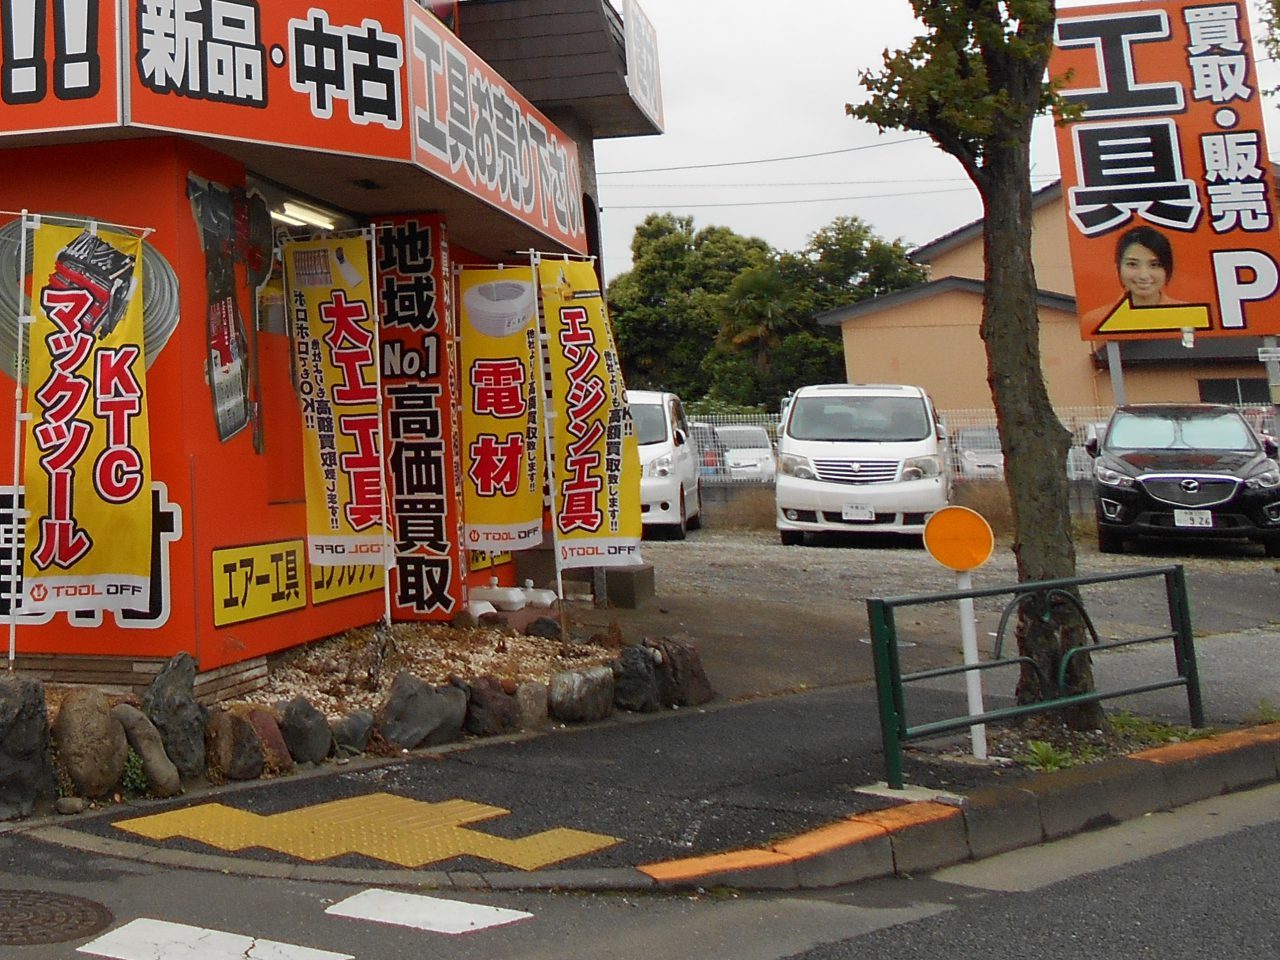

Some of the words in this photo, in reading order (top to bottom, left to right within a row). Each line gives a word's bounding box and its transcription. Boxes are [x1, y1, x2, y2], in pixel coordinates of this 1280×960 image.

[411, 15, 586, 238] 工具お売り下さい
[1054, 9, 1202, 237] 工具
[1183, 2, 1272, 233] 買取・販売
[1211, 248, 1280, 329] P
[31, 287, 95, 571] マックツール
[94, 344, 143, 504] KTC
[469, 357, 527, 497] 電材
[558, 306, 606, 534] エンジン工具
[52, 584, 102, 596] TOOL
[107, 584, 142, 596] OFF
[223, 550, 299, 608] エアー工具
[483, 531, 515, 541] TOOL
[518, 527, 539, 539] OFF
[569, 547, 604, 556] TOOL
[608, 546, 636, 555] OFF
